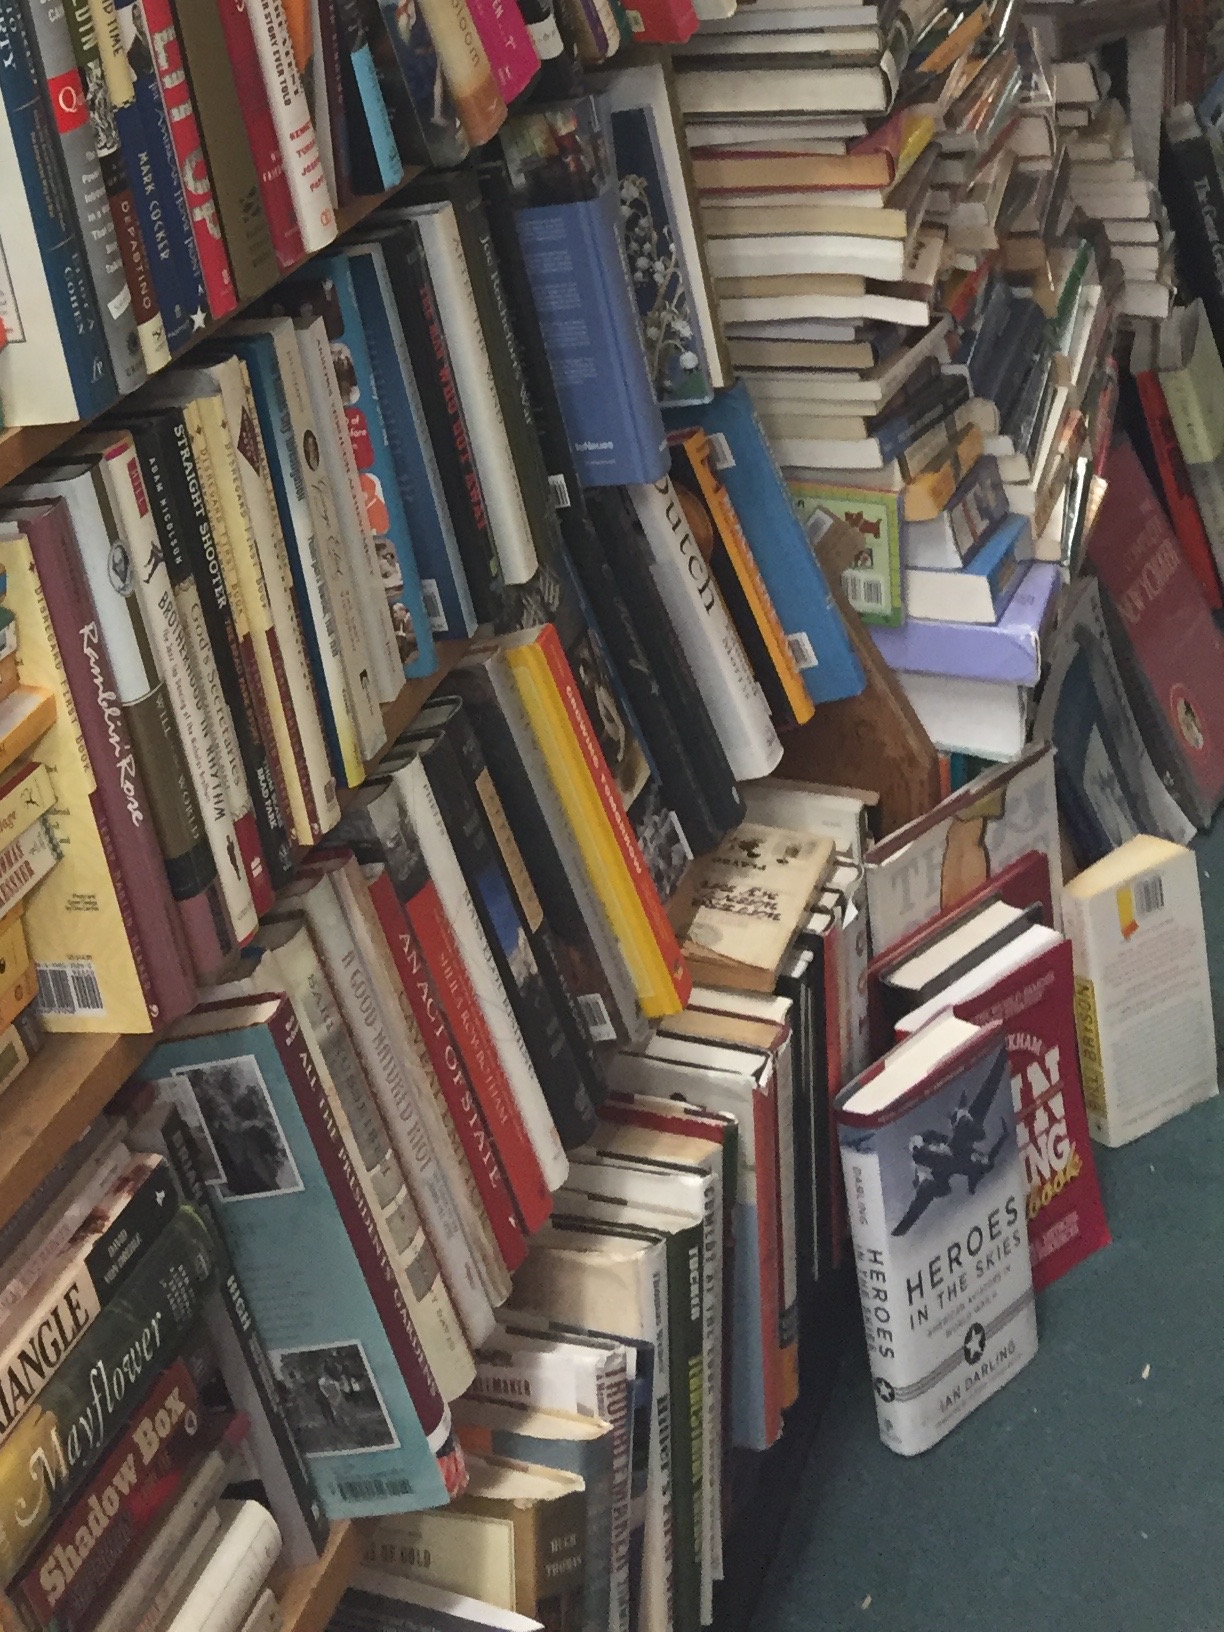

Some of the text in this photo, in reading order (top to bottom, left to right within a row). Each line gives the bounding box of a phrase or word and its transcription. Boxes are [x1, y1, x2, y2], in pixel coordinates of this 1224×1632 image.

[107, 17, 126, 58] TIME
[137, 151, 170, 261] MARK COCKER
[149, 458, 164, 497] ADAM
[174, 423, 227, 609] STRAIGHT SHOOTER
[398, 933, 500, 1189] AN ACT OF STATE
[1077, 984, 1096, 1062] BRYSON
[867, 1249, 895, 1359] HEROES
[906, 1195, 1018, 1305] HEROES
[910, 1305, 929, 1330] IN
[937, 1272, 968, 1309] THE
[976, 1230, 1021, 1279] SKIES
[17, 1311, 162, 1527] Mayflower
[939, 1338, 1016, 1413] IAN DARLING
[39, 1387, 187, 1607] Shadow Box
